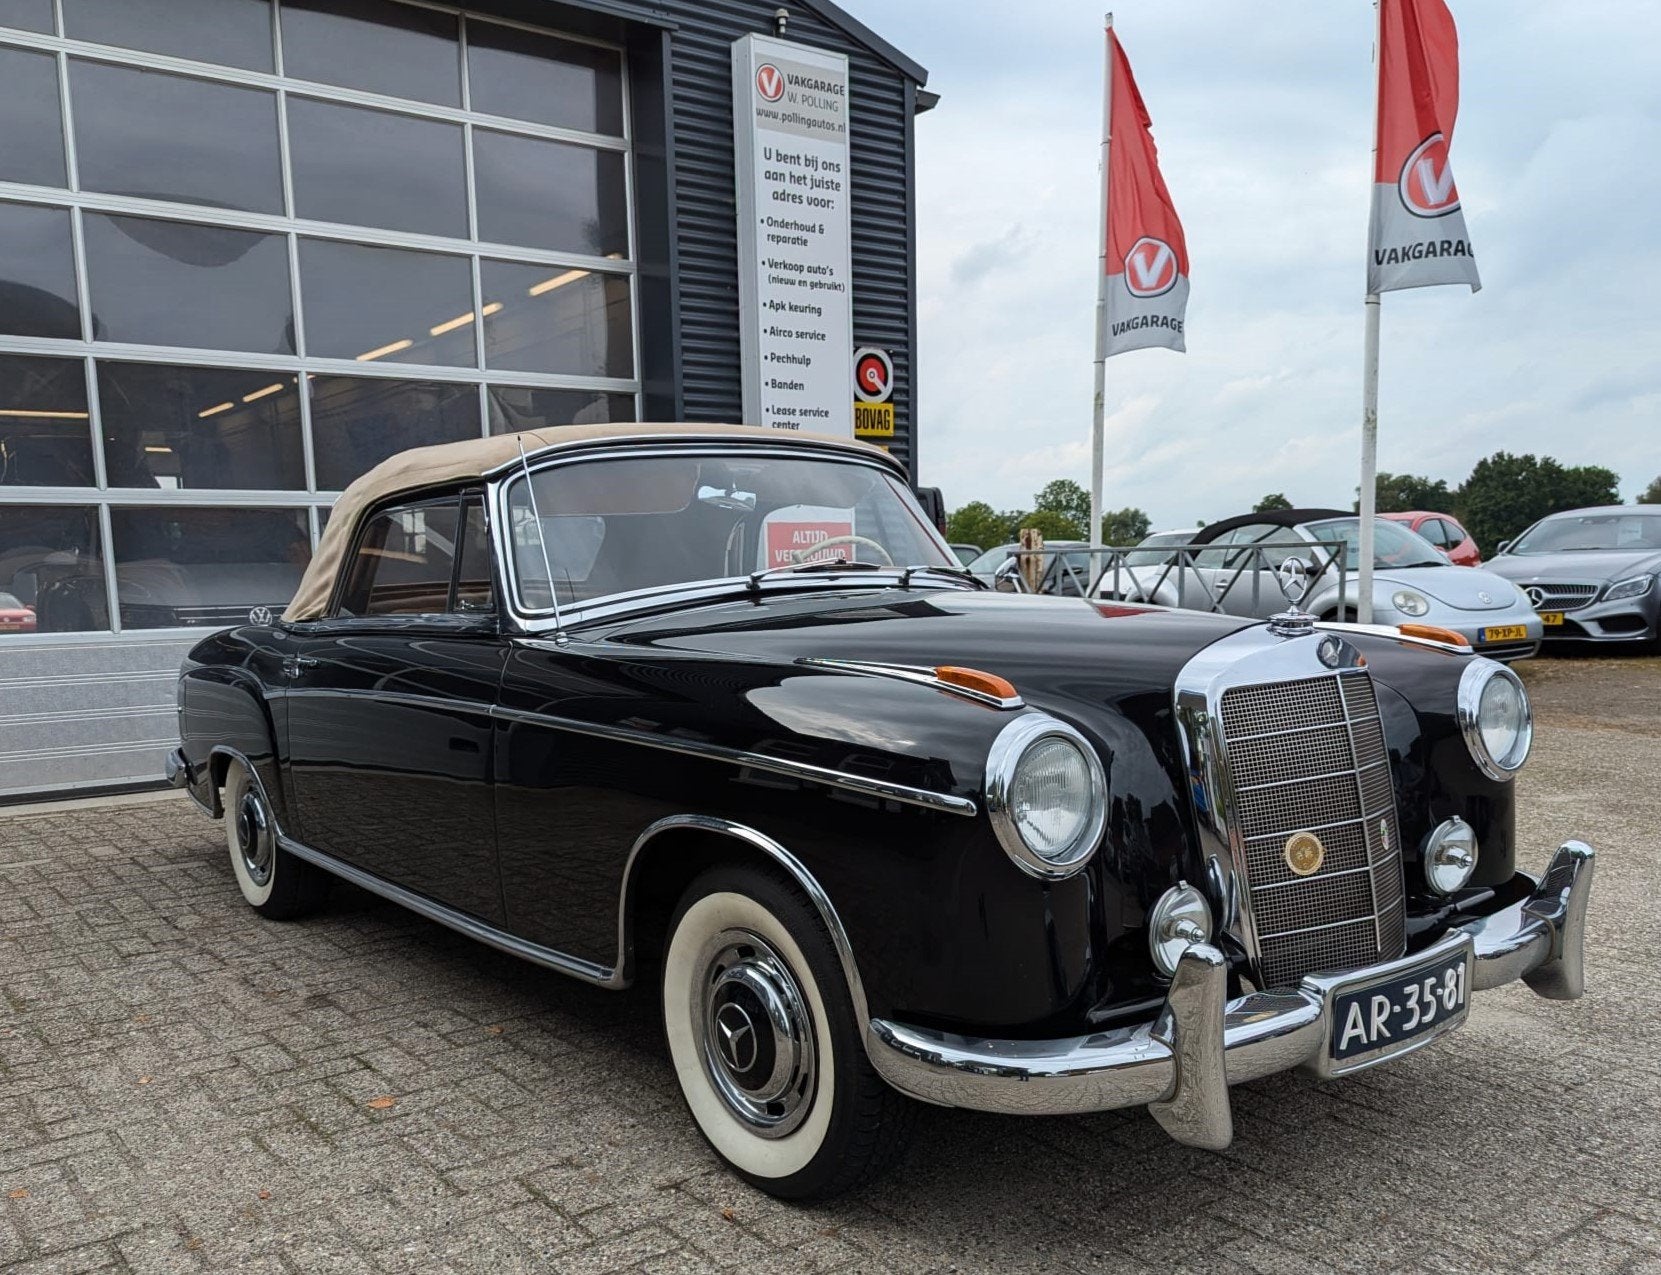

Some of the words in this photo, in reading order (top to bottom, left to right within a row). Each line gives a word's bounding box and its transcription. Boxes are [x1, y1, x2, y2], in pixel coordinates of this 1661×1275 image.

[787, 73, 845, 96] VAKGARAGE
[787, 91, 799, 104] W.
[801, 94, 839, 112] POLLING
[756, 107, 846, 132] www.pollingautos.nl
[763, 146, 772, 161] U
[775, 149, 802, 166] bent
[804, 153, 819, 172] bij
[821, 160, 841, 173] ons
[764, 170, 786, 183] aan
[789, 171, 808, 187] het
[809, 174, 841, 192] juiste
[772, 189, 804, 205] adres
[806, 195, 835, 210] voor:
[766, 216, 816, 234] Onderhoud
[818, 224, 825, 235] &
[766, 233, 809, 247] reparatie
[767, 258, 805, 274] Verkoop
[806, 264, 834, 277] auto's
[767, 273, 796, 286] (nieuw
[798, 280, 808, 288] en
[809, 281, 846, 294] gebruikt)
[768, 299, 786, 313] Apk
[788, 301, 822, 318] keuring
[769, 325, 793, 338] Airco
[795, 329, 826, 342] service
[1111, 314, 1185, 337] VAKGARAGE
[770, 352, 812, 368] Pechhulp
[771, 378, 805, 391] Banden
[771, 404, 797, 417] Lease
[798, 407, 830, 419] service
[855, 407, 891, 431] BOVAG
[772, 420, 801, 431] center
[793, 530, 828, 543] ALTIJD
[1340, 962, 1466, 1050] AR-35-81
